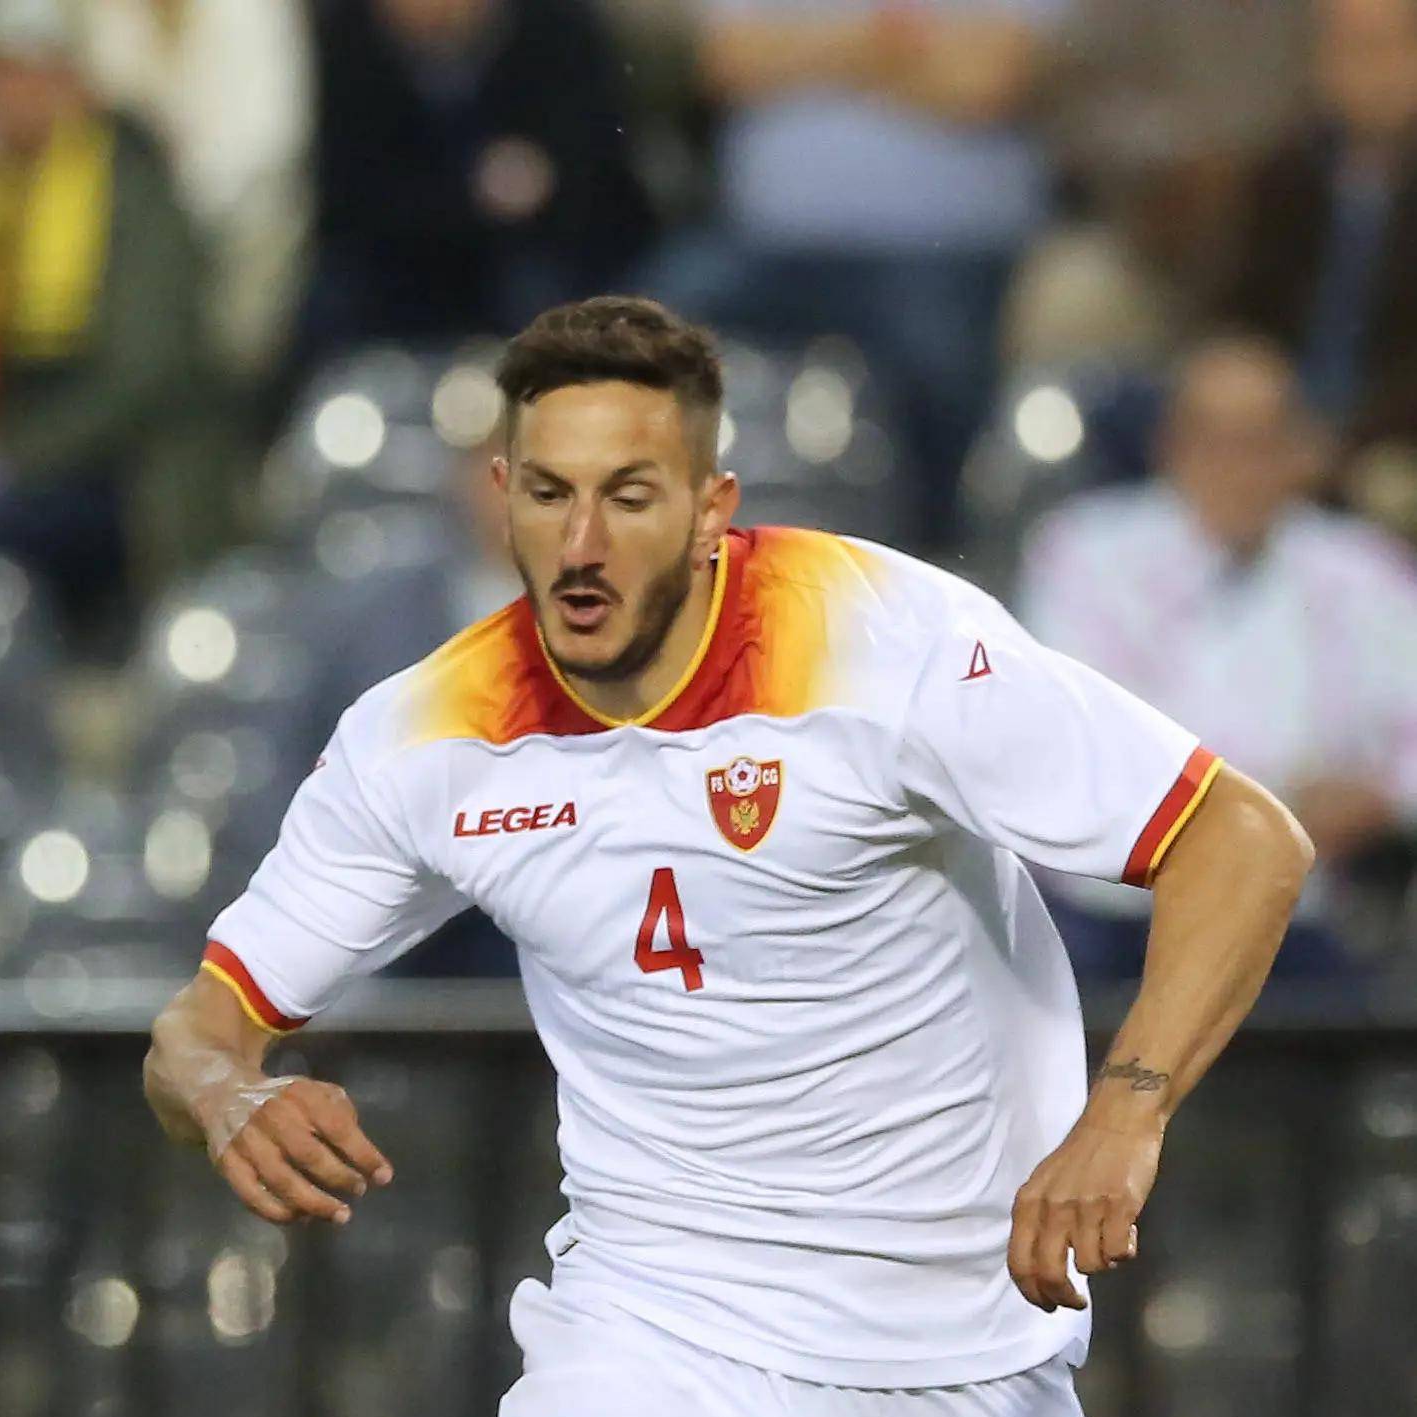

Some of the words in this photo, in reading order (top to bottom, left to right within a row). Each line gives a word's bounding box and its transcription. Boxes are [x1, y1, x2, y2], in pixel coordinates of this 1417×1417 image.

[710, 776, 725, 793] FS
[762, 767, 778, 786] CG
[453, 801, 577, 838] LEGEA
[633, 867, 705, 993] 4
